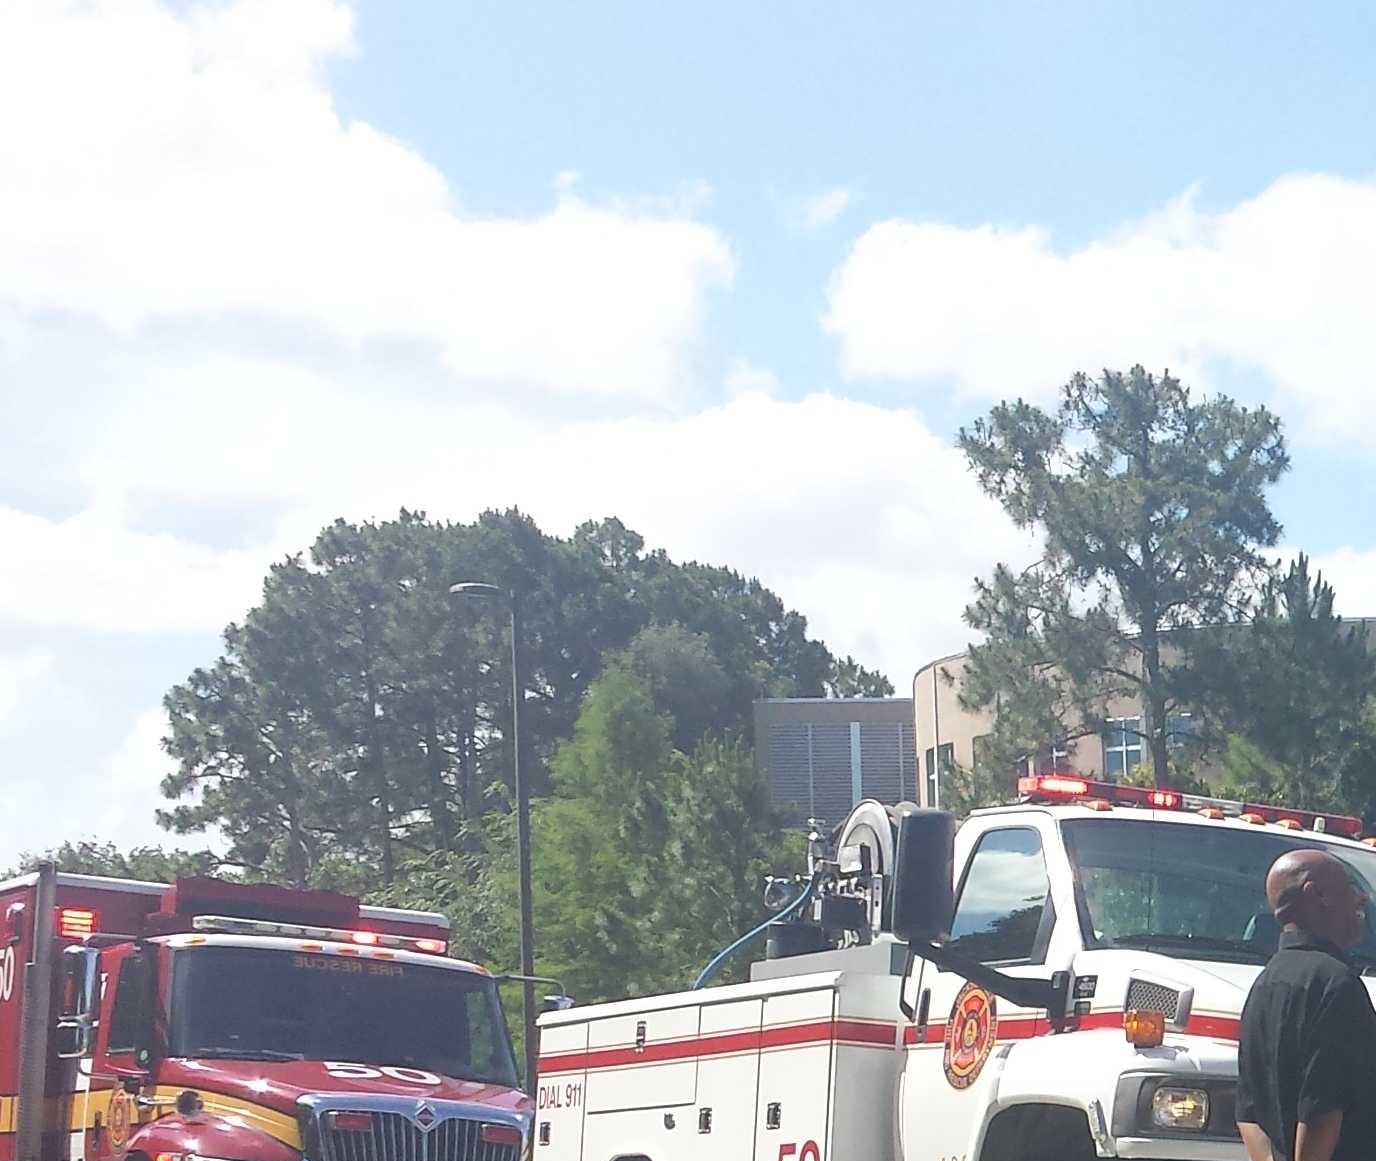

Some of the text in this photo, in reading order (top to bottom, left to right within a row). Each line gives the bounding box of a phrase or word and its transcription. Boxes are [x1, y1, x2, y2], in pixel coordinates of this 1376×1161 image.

[322, 1061, 442, 1085] 50
[538, 1083, 582, 1110] DIAL 911
